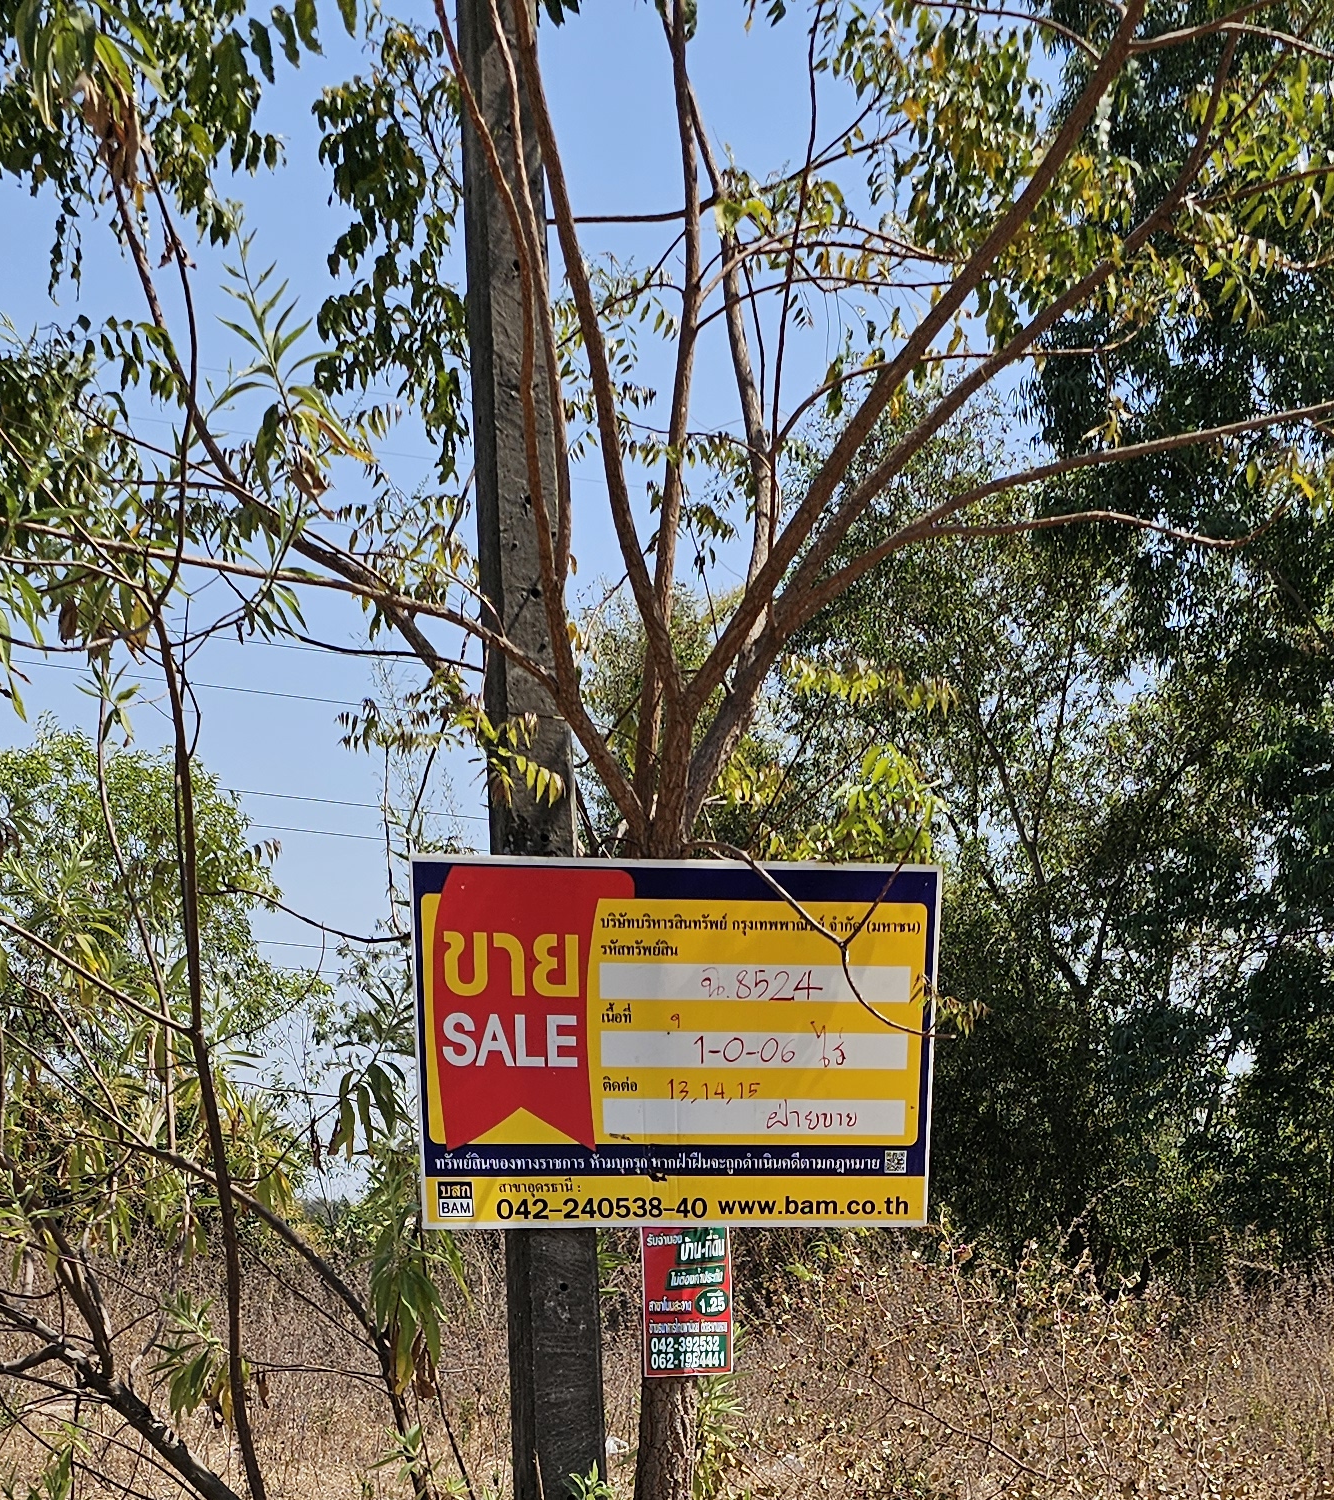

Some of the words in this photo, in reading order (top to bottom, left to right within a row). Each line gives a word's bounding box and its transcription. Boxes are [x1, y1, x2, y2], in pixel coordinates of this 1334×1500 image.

[600, 912, 728, 931] บริษัทบริหารสินทรัพย์
[866, 919, 921, 934] (มหาชน)
[600, 940, 678, 956] รหัสทรัพย์สิน
[443, 931, 579, 997] ขาย
[601, 1002, 632, 1023] เนื้อที่
[442, 1012, 578, 1068] SALE
[693, 1035, 795, 1064] 1-0-06
[602, 1076, 638, 1092] ติดต่อ
[767, 1099, 857, 1130] ฝ่ายขาย
[435, 1151, 584, 1170] ทรัพย์สินของทางราชการ
[590, 1152, 648, 1174] ห้ามบุกรุก
[440, 1185, 471, 1197] บสก
[498, 1178, 574, 1198] สาขาอุดรธานี
[441, 1202, 471, 1214] BAM
[496, 1197, 708, 1220] 042-240538-40
[718, 1195, 909, 1216] www.bam.co.th
[699, 1296, 726, 1313] 1.25
[650, 1336, 720, 1352] 042-392532
